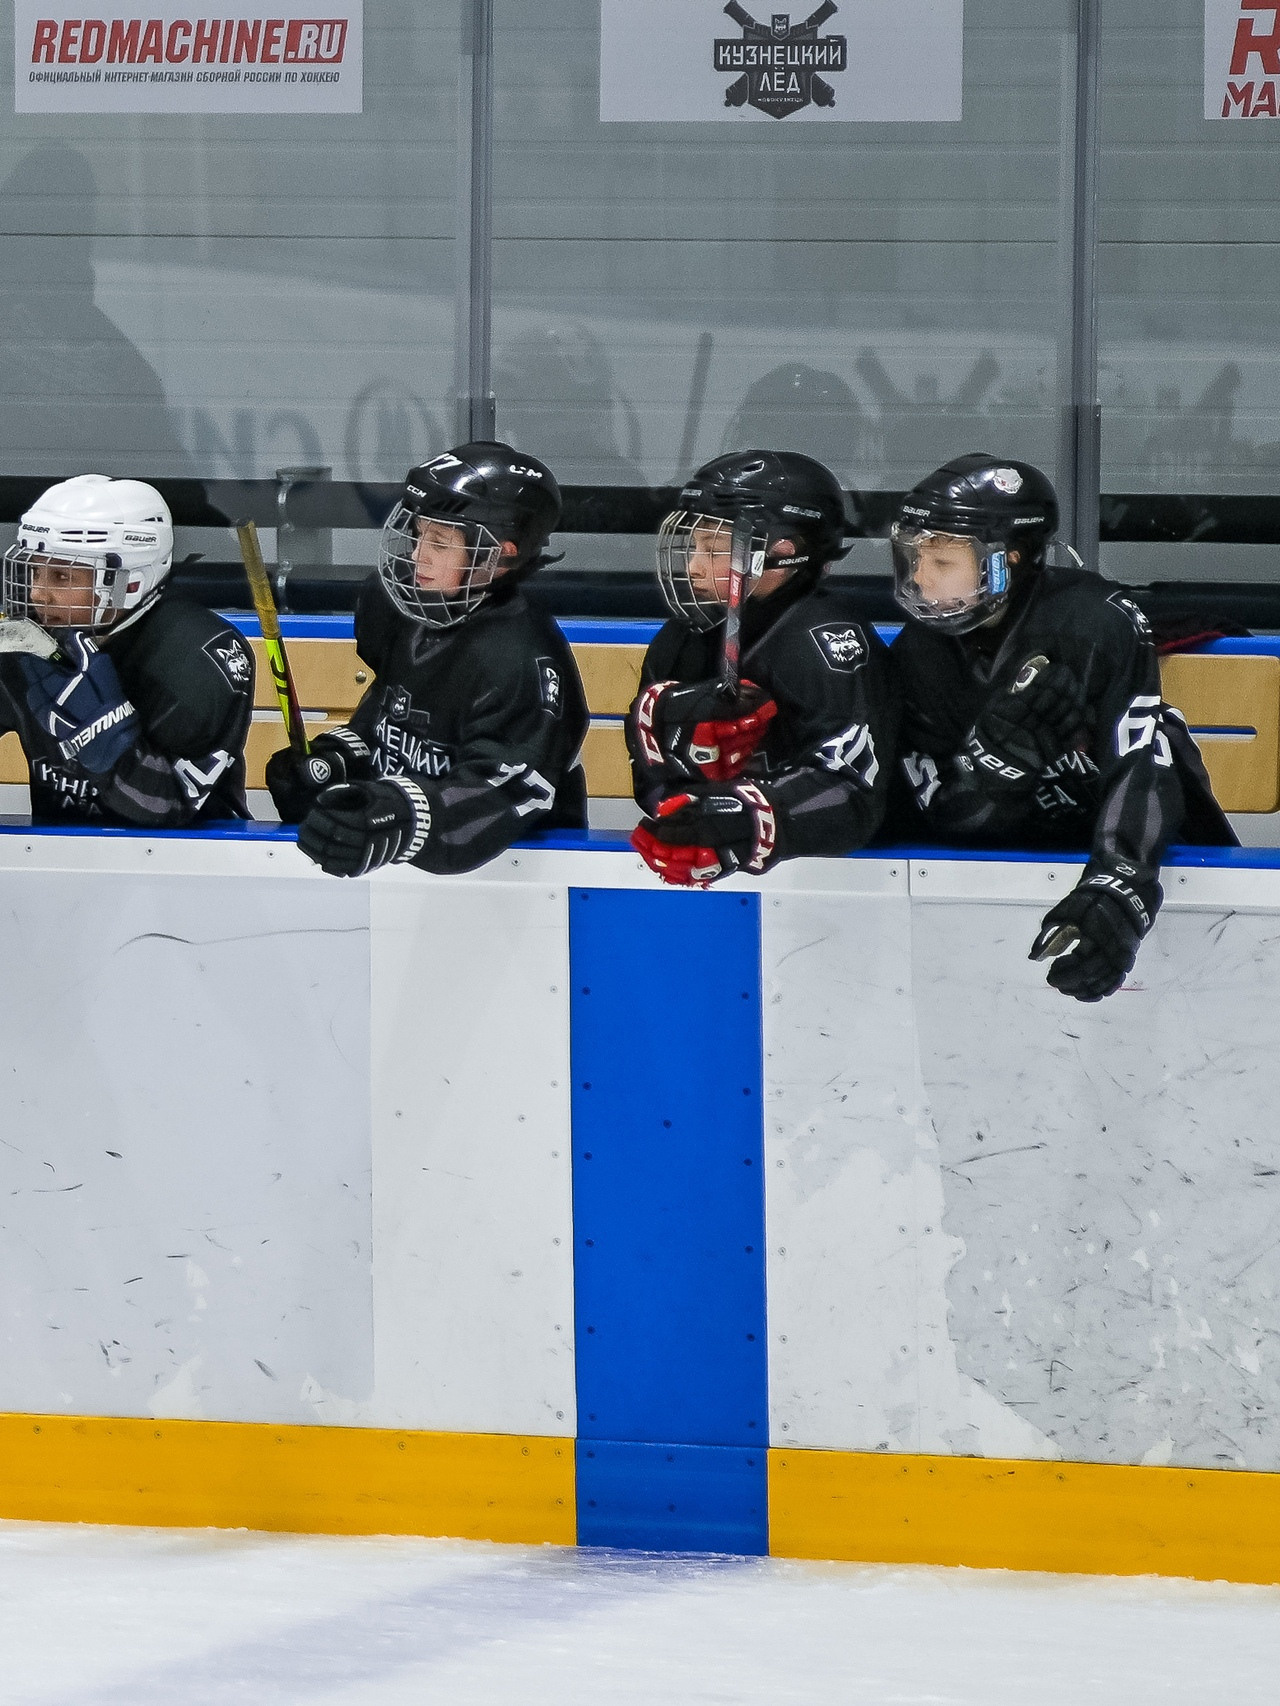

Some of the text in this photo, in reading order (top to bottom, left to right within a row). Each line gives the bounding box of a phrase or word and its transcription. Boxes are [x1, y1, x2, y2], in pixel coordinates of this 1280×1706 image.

[32, 19, 348, 63] REDMACHINE.RU
[719, 38, 842, 66] КУЗНЕЦКИЙ
[28, 69, 340, 84] ОФИЦИАЛЬНЫЙ ИНТЕРНЕТ-МАГАЗИН СБОРНОЙ РОССИИ ПО ХОККЕЮ
[760, 66, 801, 94] ЛЁД
[406, 484, 428, 498] CCM
[902, 505, 931, 517] BAUER
[22, 523, 51, 534] BAUER
[124, 534, 157, 543] BAUER
[778, 555, 810, 566] BAUER
[736, 782, 776, 870] CCM
[1087, 873, 1151, 929] AUER
